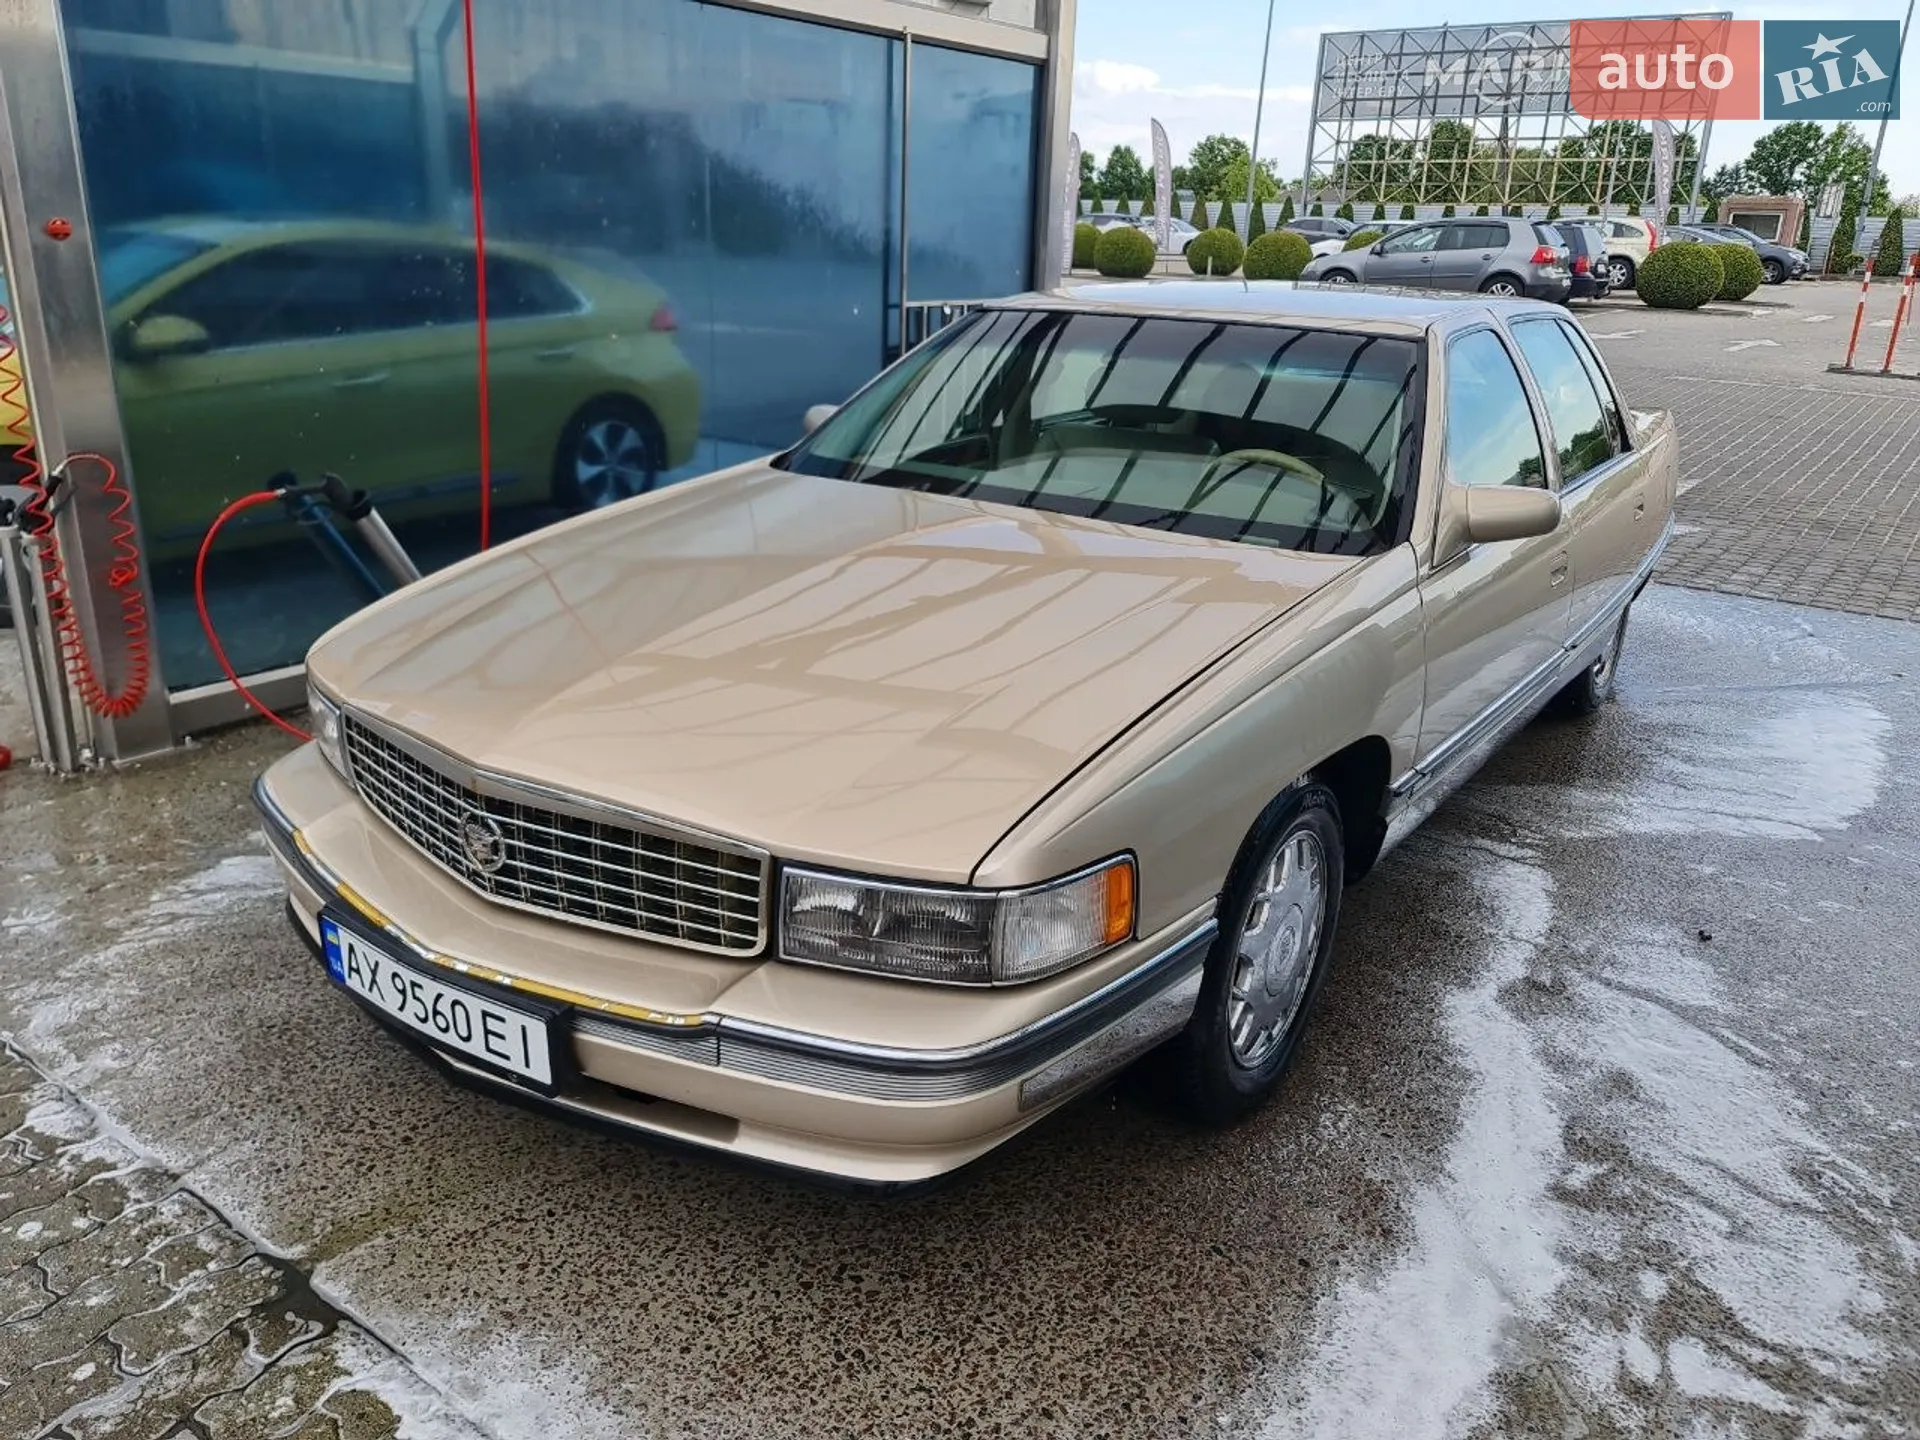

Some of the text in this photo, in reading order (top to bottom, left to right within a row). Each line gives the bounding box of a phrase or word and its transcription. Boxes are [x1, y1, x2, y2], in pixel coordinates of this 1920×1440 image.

[347, 942, 531, 1069] AX 9560 EI
